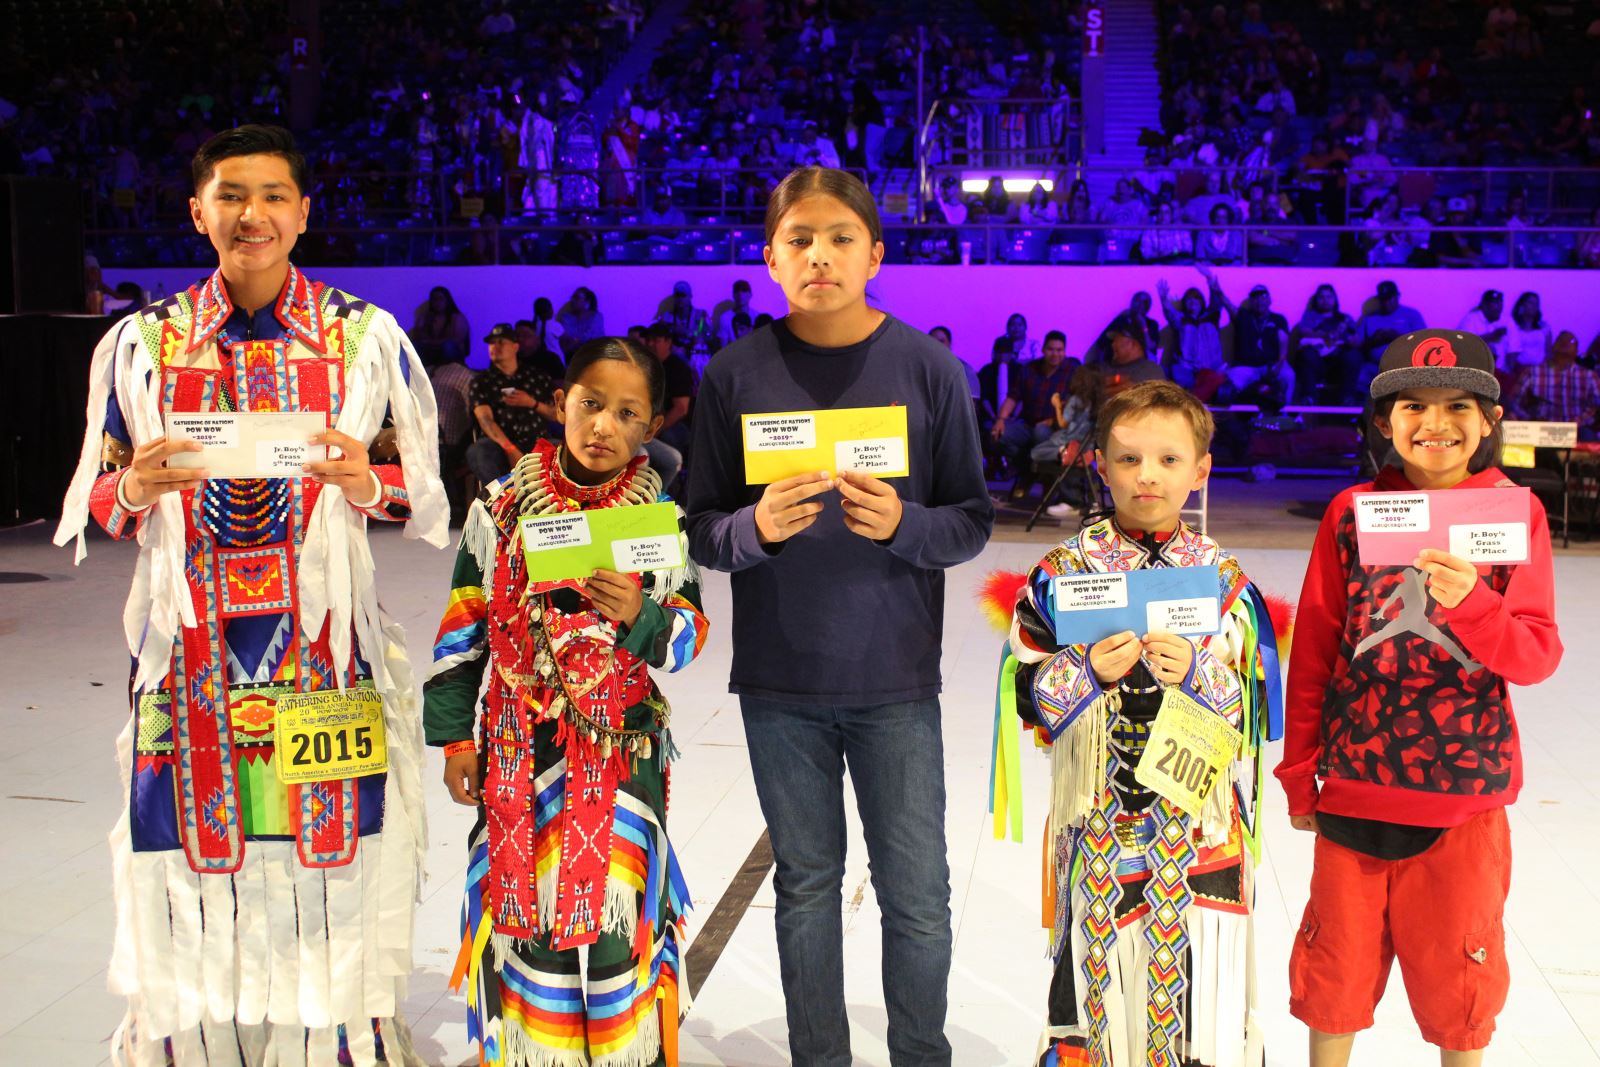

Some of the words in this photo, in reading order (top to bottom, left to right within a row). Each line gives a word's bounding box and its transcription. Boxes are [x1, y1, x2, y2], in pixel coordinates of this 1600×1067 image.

[293, 38, 307, 56] R
[274, 446, 283, 454] Jr.
[864, 445, 886, 453] Boy's
[526, 521, 554, 529] GATHERING
[1470, 531, 1481, 539] Jr.
[277, 694, 330, 714] GATHERING
[332, 694, 343, 702] OF
[346, 690, 382, 704] NATIONS
[1167, 694, 1210, 722] GATHERING
[291, 726, 373, 766] 2015
[1155, 738, 1218, 800] 2005
